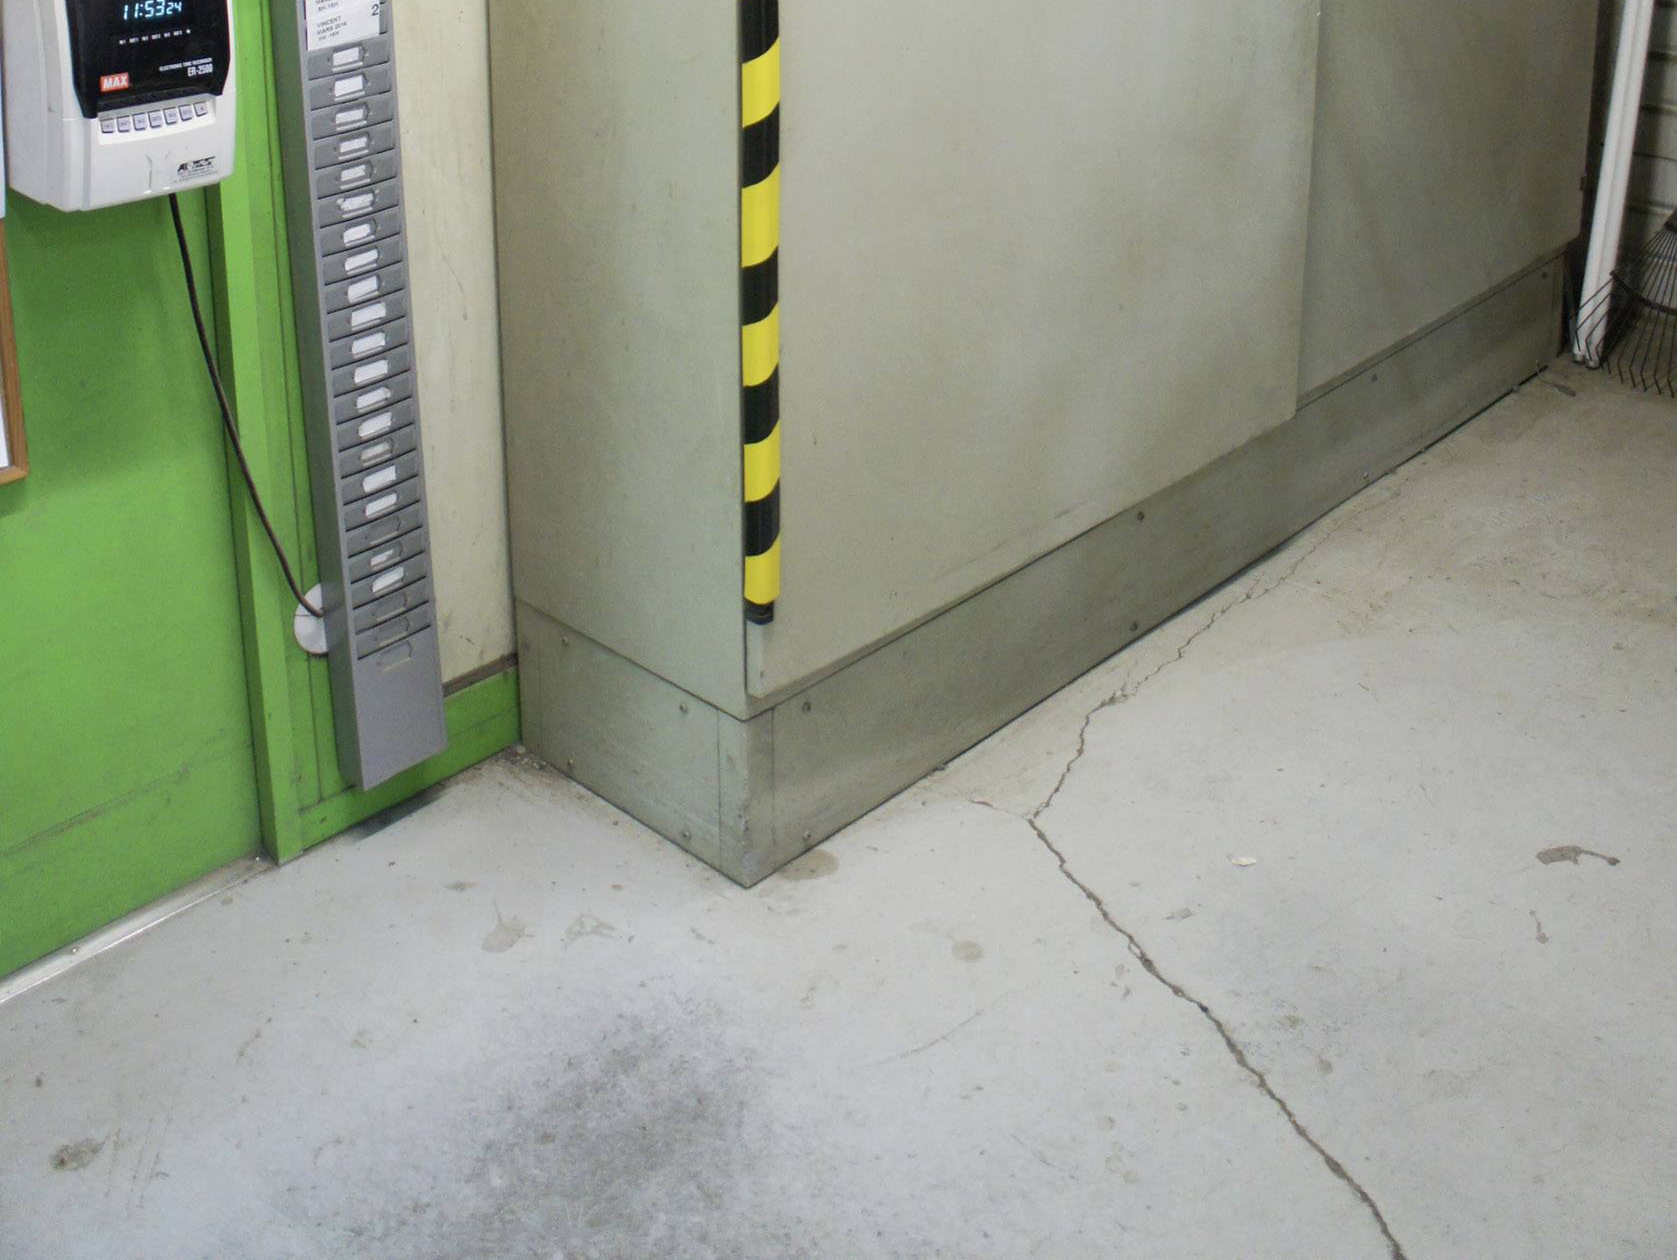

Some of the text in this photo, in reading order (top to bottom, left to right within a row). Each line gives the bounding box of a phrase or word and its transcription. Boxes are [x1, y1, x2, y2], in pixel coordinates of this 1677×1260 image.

[166, 1, 183, 15] 24
[371, 4, 379, 16] 2
[103, 75, 128, 89] MAX
